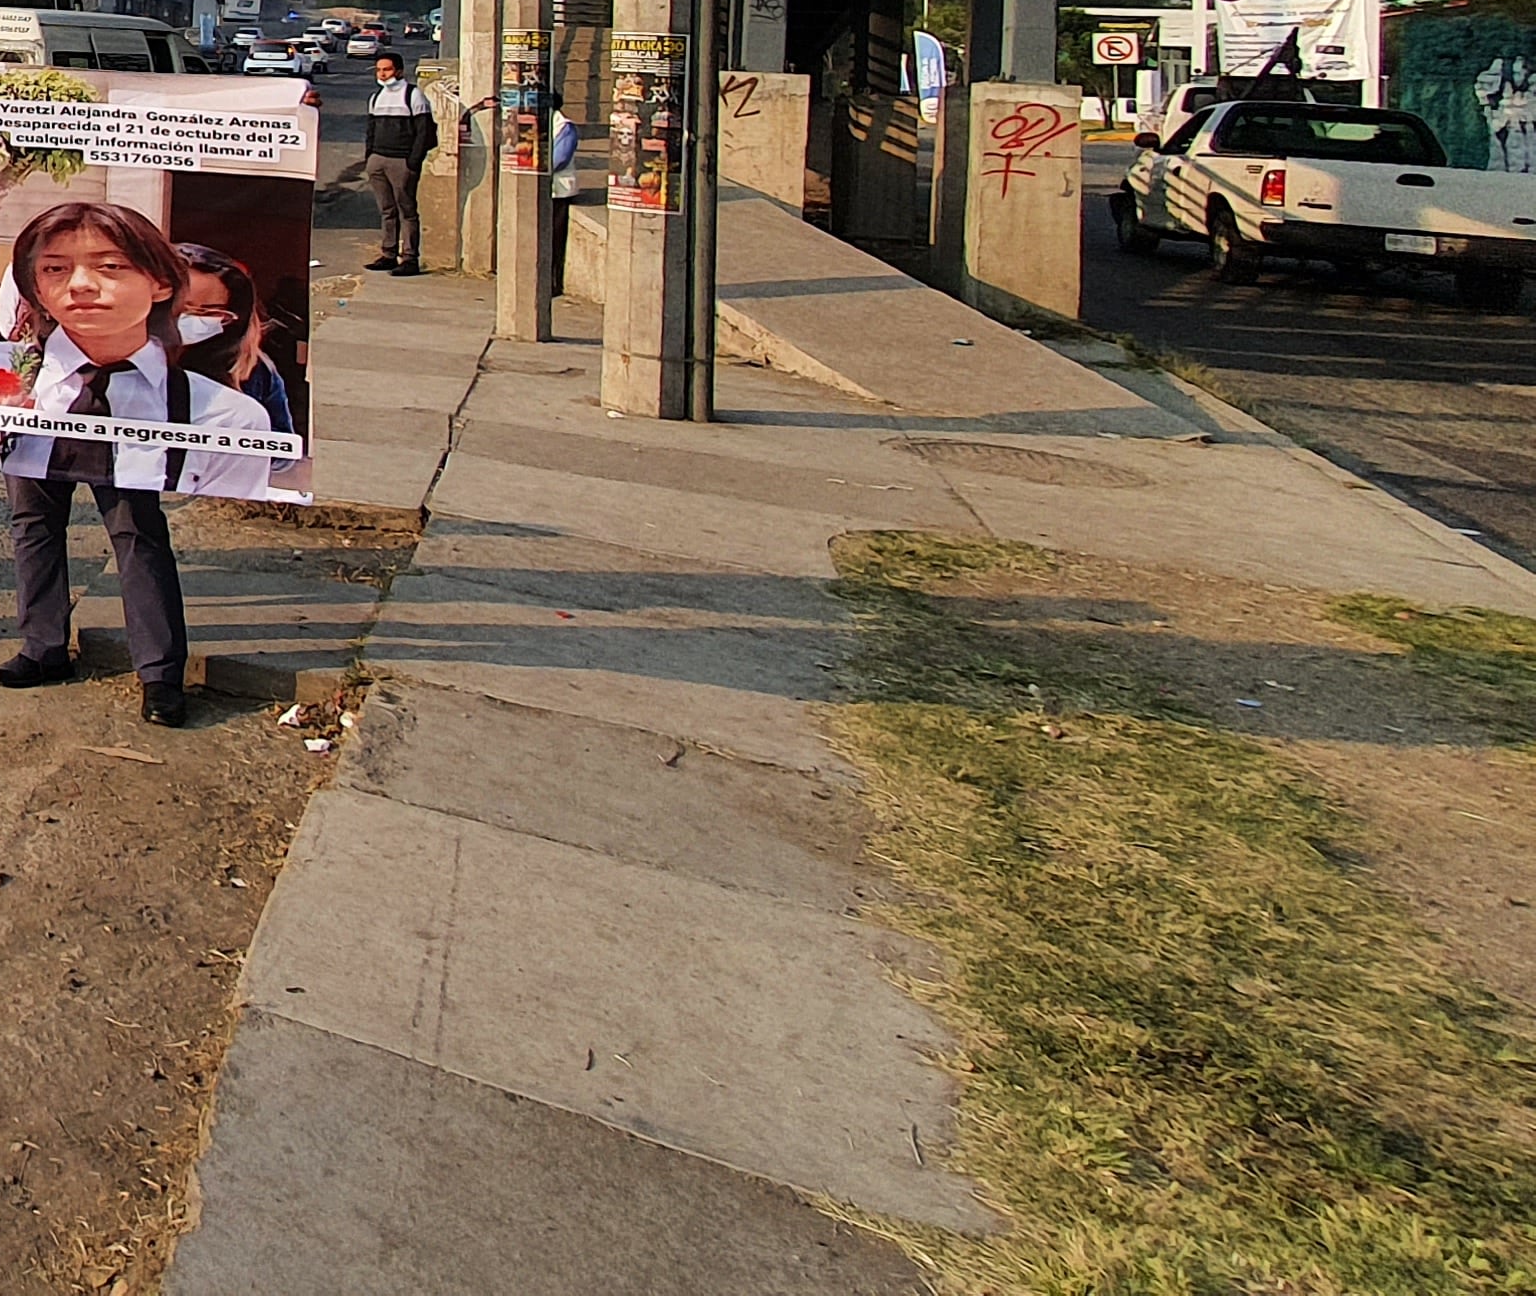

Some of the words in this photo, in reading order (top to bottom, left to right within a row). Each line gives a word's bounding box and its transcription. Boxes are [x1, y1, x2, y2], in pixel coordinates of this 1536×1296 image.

[0, 102, 55, 116] Yaretzi
[60, 105, 137, 120] Alejandra
[146, 109, 224, 127] González
[229, 116, 292, 130] Arenas
[15, 132, 91, 148] cualquier
[95, 135, 194, 153] información
[199, 142, 254, 157] llamar
[257, 147, 274, 159] al
[106, 121, 121, 133] el
[125, 123, 145, 135] 21
[150, 124, 171, 137] de
[175, 127, 242, 142] octubre
[246, 131, 273, 144] del
[278, 134, 301, 146] 22
[89, 150, 195, 168] 5531760356
[93, 423, 108, 436] a
[113, 425, 212, 445] regresar
[217, 434, 232, 448] a
[238, 437, 294, 453] casa
